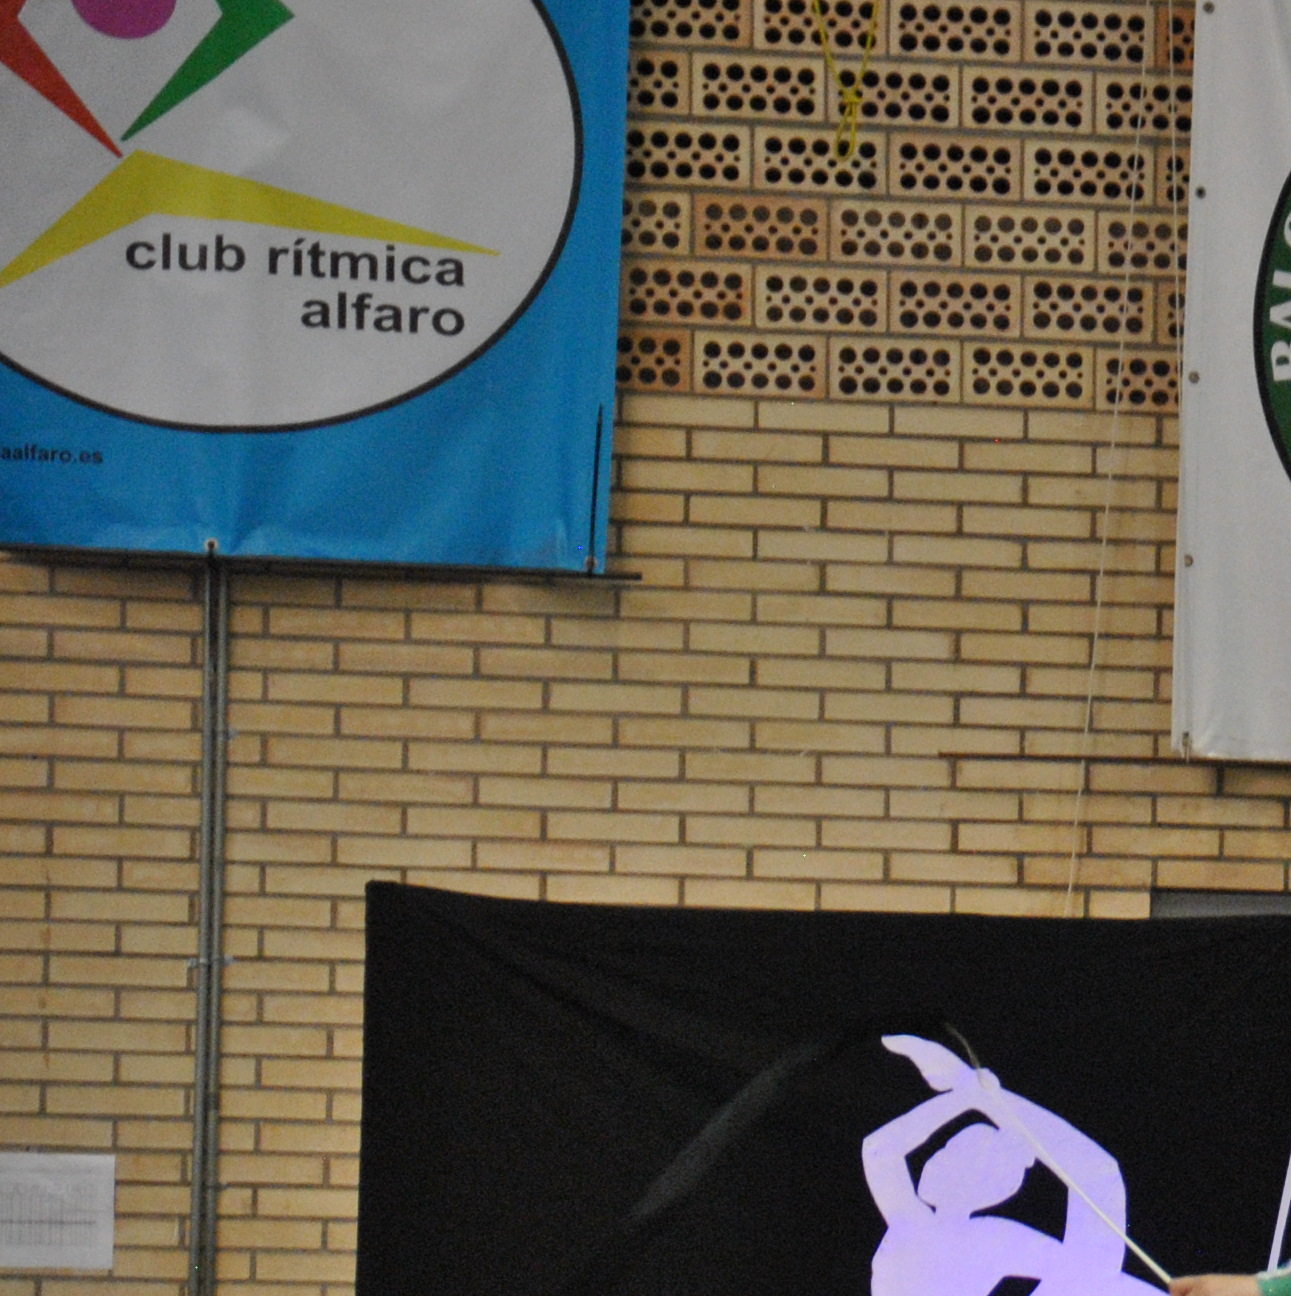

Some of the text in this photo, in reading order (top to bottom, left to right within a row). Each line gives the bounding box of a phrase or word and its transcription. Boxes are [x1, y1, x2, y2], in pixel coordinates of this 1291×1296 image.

[125, 234, 466, 287] club rítmica
[301, 292, 466, 337] alfaro
